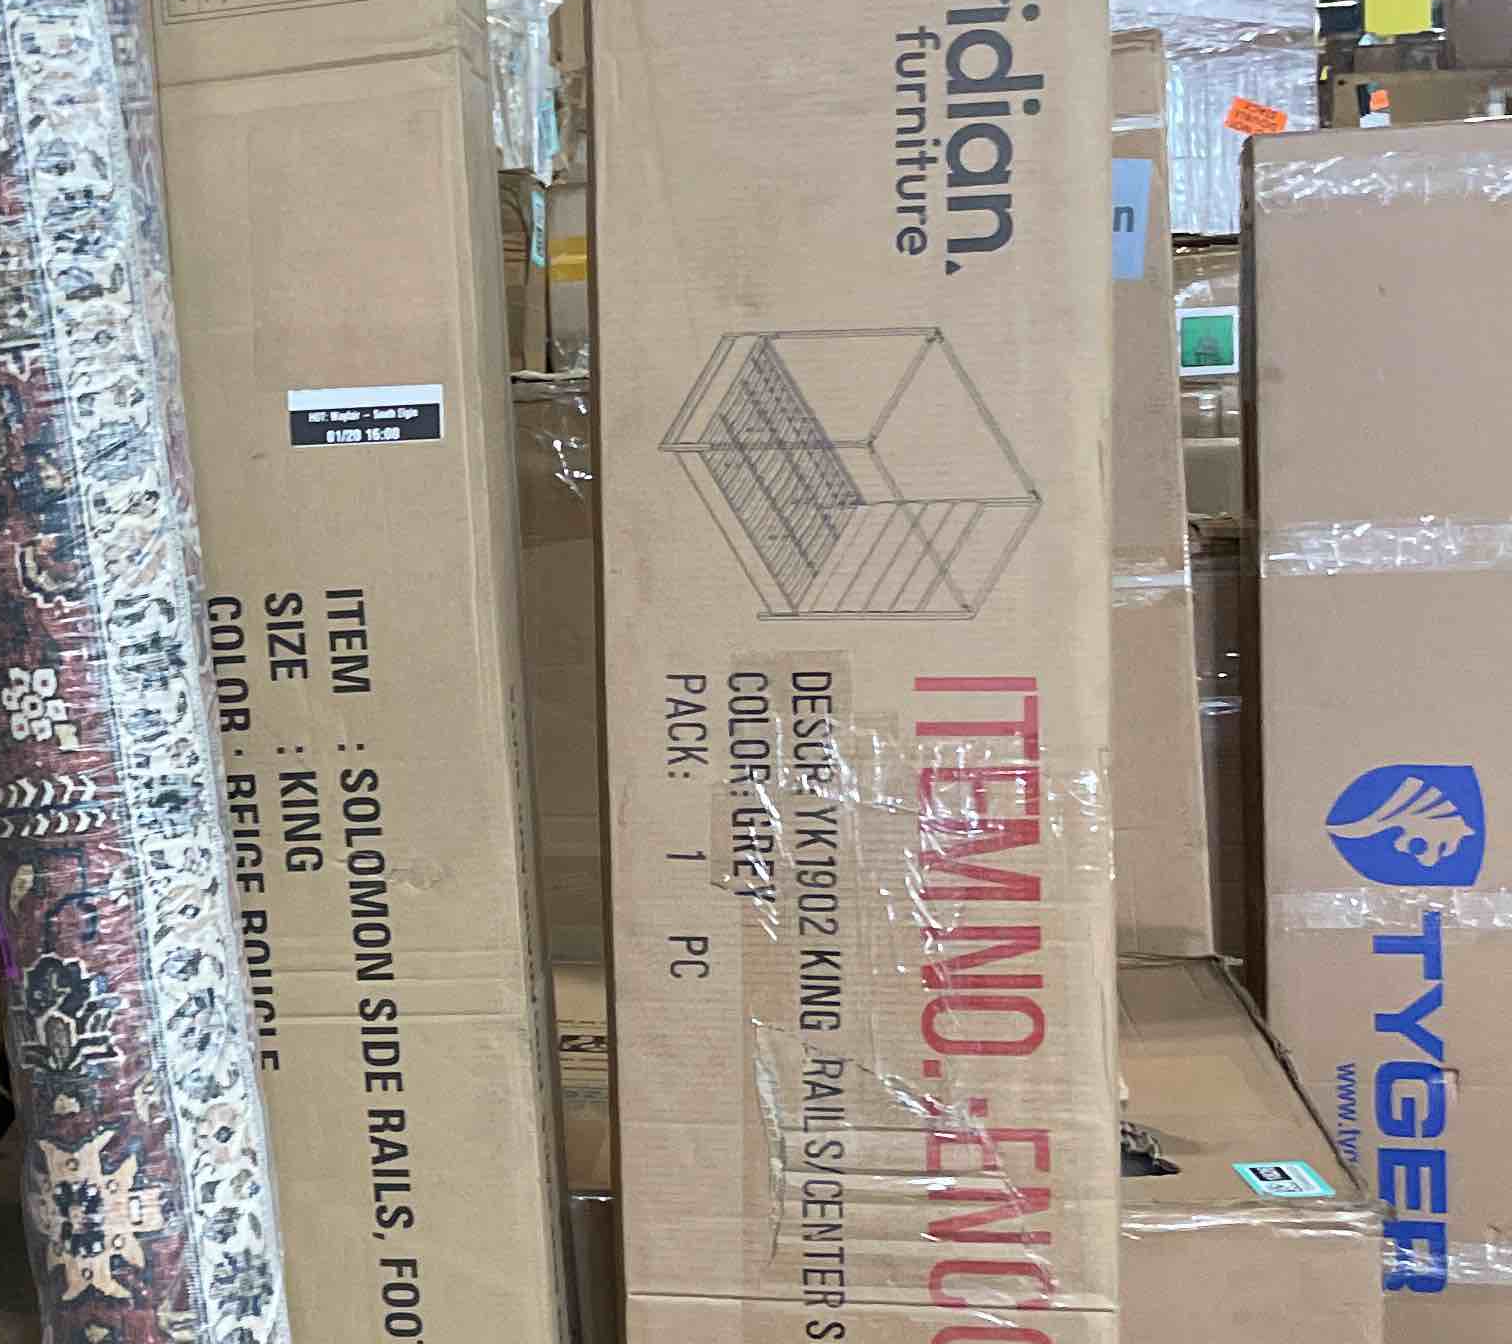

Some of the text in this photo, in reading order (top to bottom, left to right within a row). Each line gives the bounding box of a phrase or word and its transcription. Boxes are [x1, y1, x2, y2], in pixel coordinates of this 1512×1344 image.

[895, 25, 940, 256] furniture
[207, 596, 251, 733] COLOR
[264, 592, 309, 682] SIZE
[325, 588, 372, 694] ITEM
[666, 674, 708, 778] PACK:
[727, 672, 776, 903] COLOR: GREY
[915, 677, 1040, 901] ITEM
[279, 770, 324, 873] KING
[340, 768, 396, 982] SOLOMON
[795, 805, 839, 936] YK1902
[668, 935, 710, 978] PC
[800, 949, 842, 1032] KING
[358, 998, 404, 1093] SIDE
[1372, 911, 1447, 1294] TYGER
[367, 1108, 415, 1241] RAILS,
